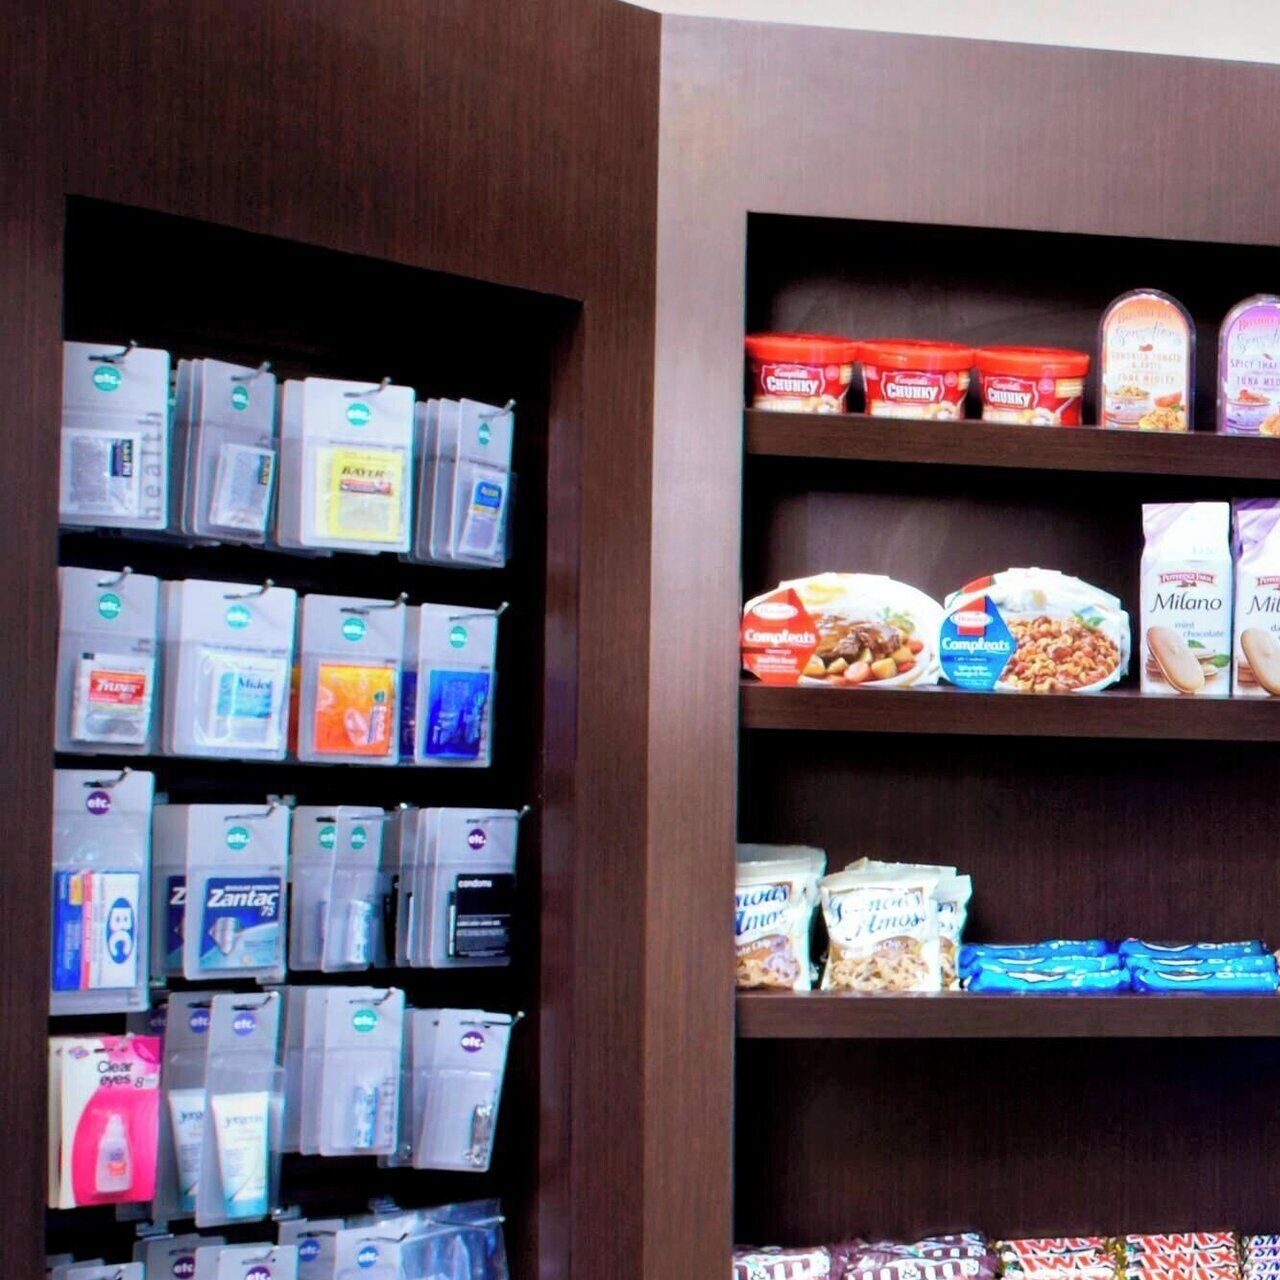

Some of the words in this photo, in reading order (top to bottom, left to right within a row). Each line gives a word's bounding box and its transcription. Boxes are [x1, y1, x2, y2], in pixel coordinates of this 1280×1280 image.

[767, 376, 818, 396] CHUNKY
[886, 381, 937, 400] CHUNKY
[988, 385, 1031, 405] CHUNKY
[1150, 592, 1222, 613] Milano
[744, 627, 817, 648] Compleats
[941, 636, 1011, 655] Compleats
[208, 888, 280, 909] Zantac
[97, 1060, 134, 1074] Clear
[101, 1074, 132, 1088] eyes
[1012, 1236, 1103, 1254] TWIX
[1139, 1231, 1234, 1254] TWIX
[1020, 1253, 1116, 1273] TWIX
[1141, 1251, 1238, 1270] TWIX
